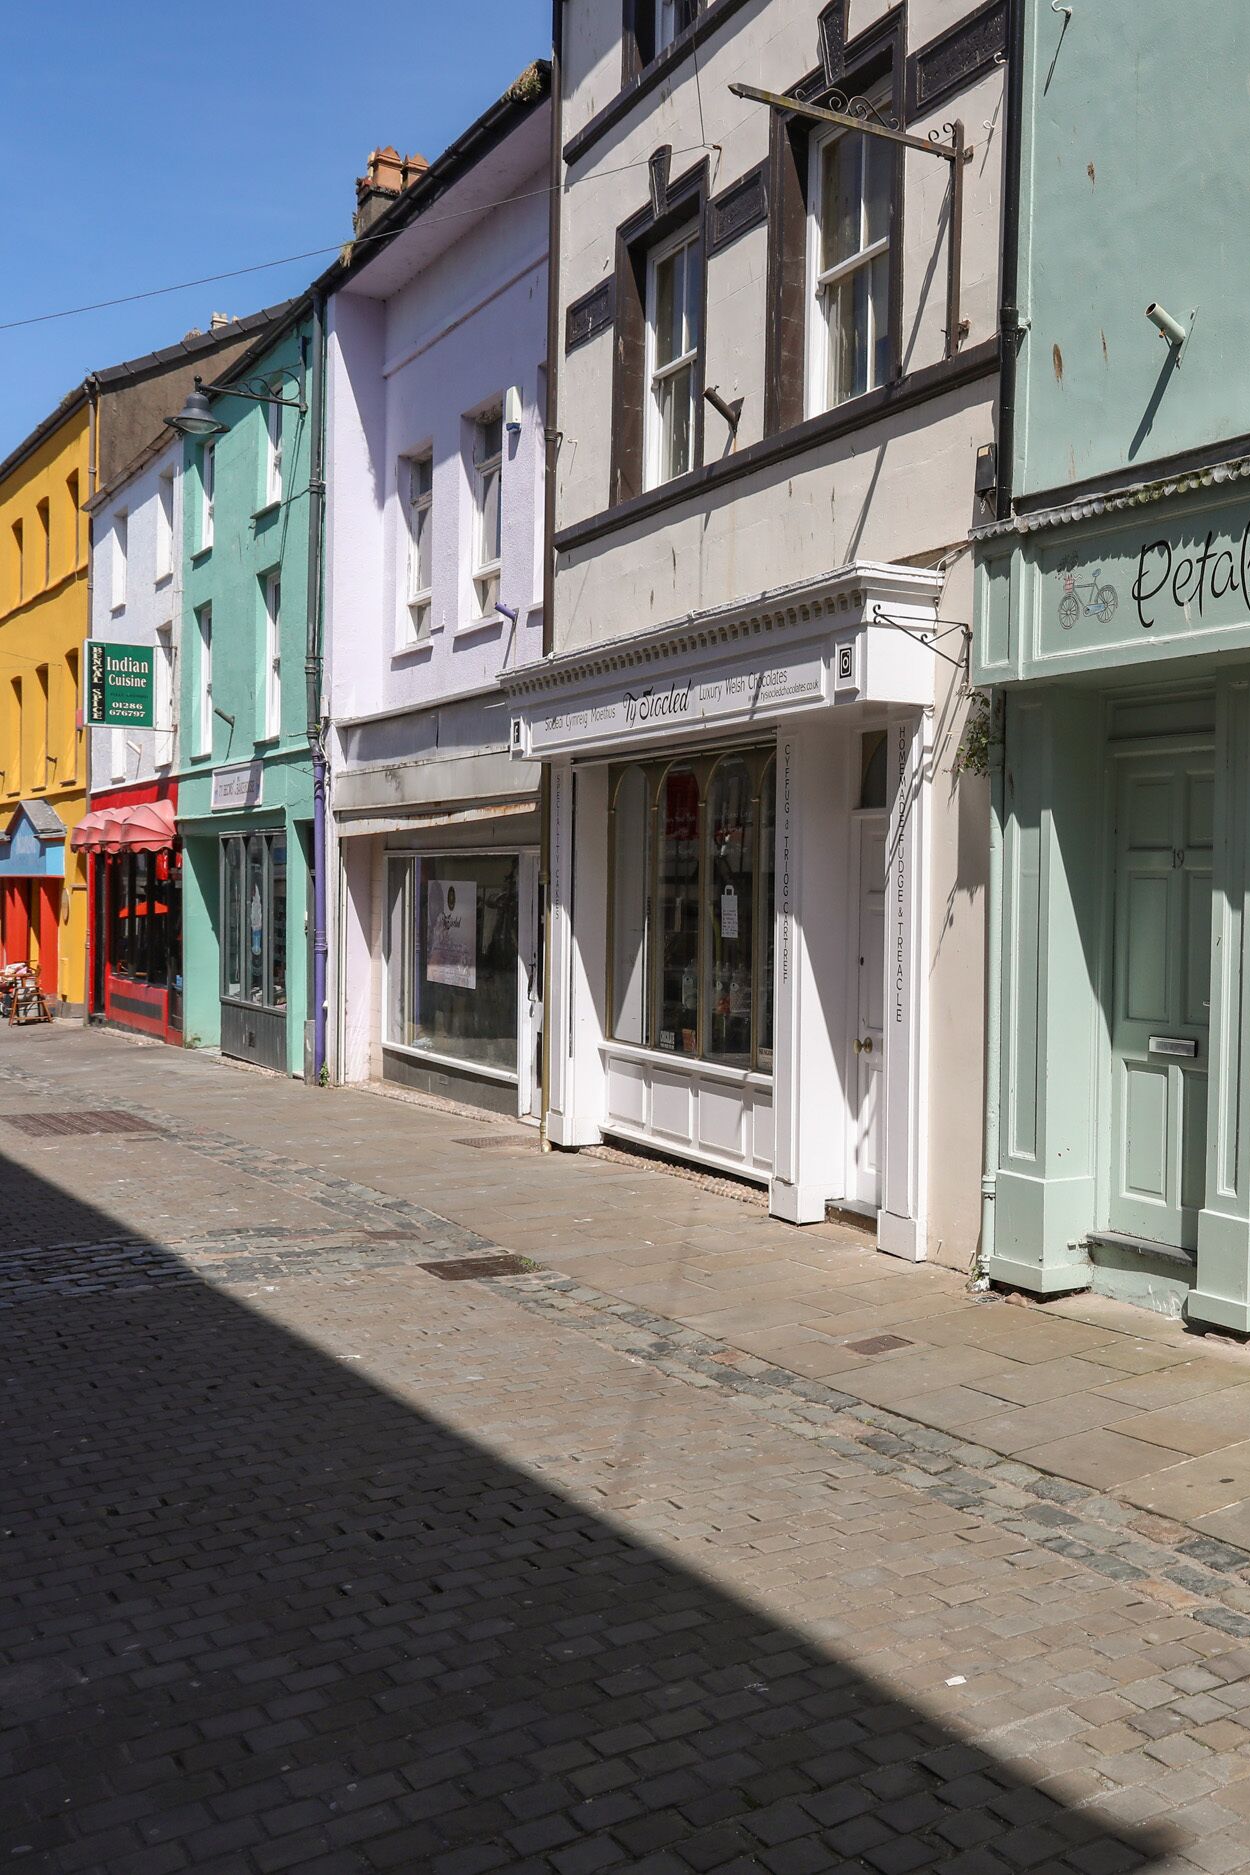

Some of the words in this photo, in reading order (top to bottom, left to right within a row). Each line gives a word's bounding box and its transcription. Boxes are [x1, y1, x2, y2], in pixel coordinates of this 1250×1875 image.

[92, 647, 103, 683] BENGAL
[106, 656, 149, 674] Indian
[108, 674, 147, 688] Cuisine
[699, 684, 722, 702] Luxury
[725, 677, 746, 696] Welsh
[747, 669, 788, 690] Chocolates
[92, 689, 103, 720] SPICE
[109, 709, 146, 718] 676797
[112, 702, 143, 710] 01286
[622, 691, 640, 729] Ty
[639, 677, 692, 721] Siocled
[565, 712, 588, 731] Cymreig
[590, 706, 616, 722] Moethus
[897, 726, 907, 828] HOMEMADE
[897, 834, 905, 902] FUDGE
[1172, 848, 1185, 869] 19
[897, 906, 904, 918] &
[896, 922, 904, 1023] TREACLE
